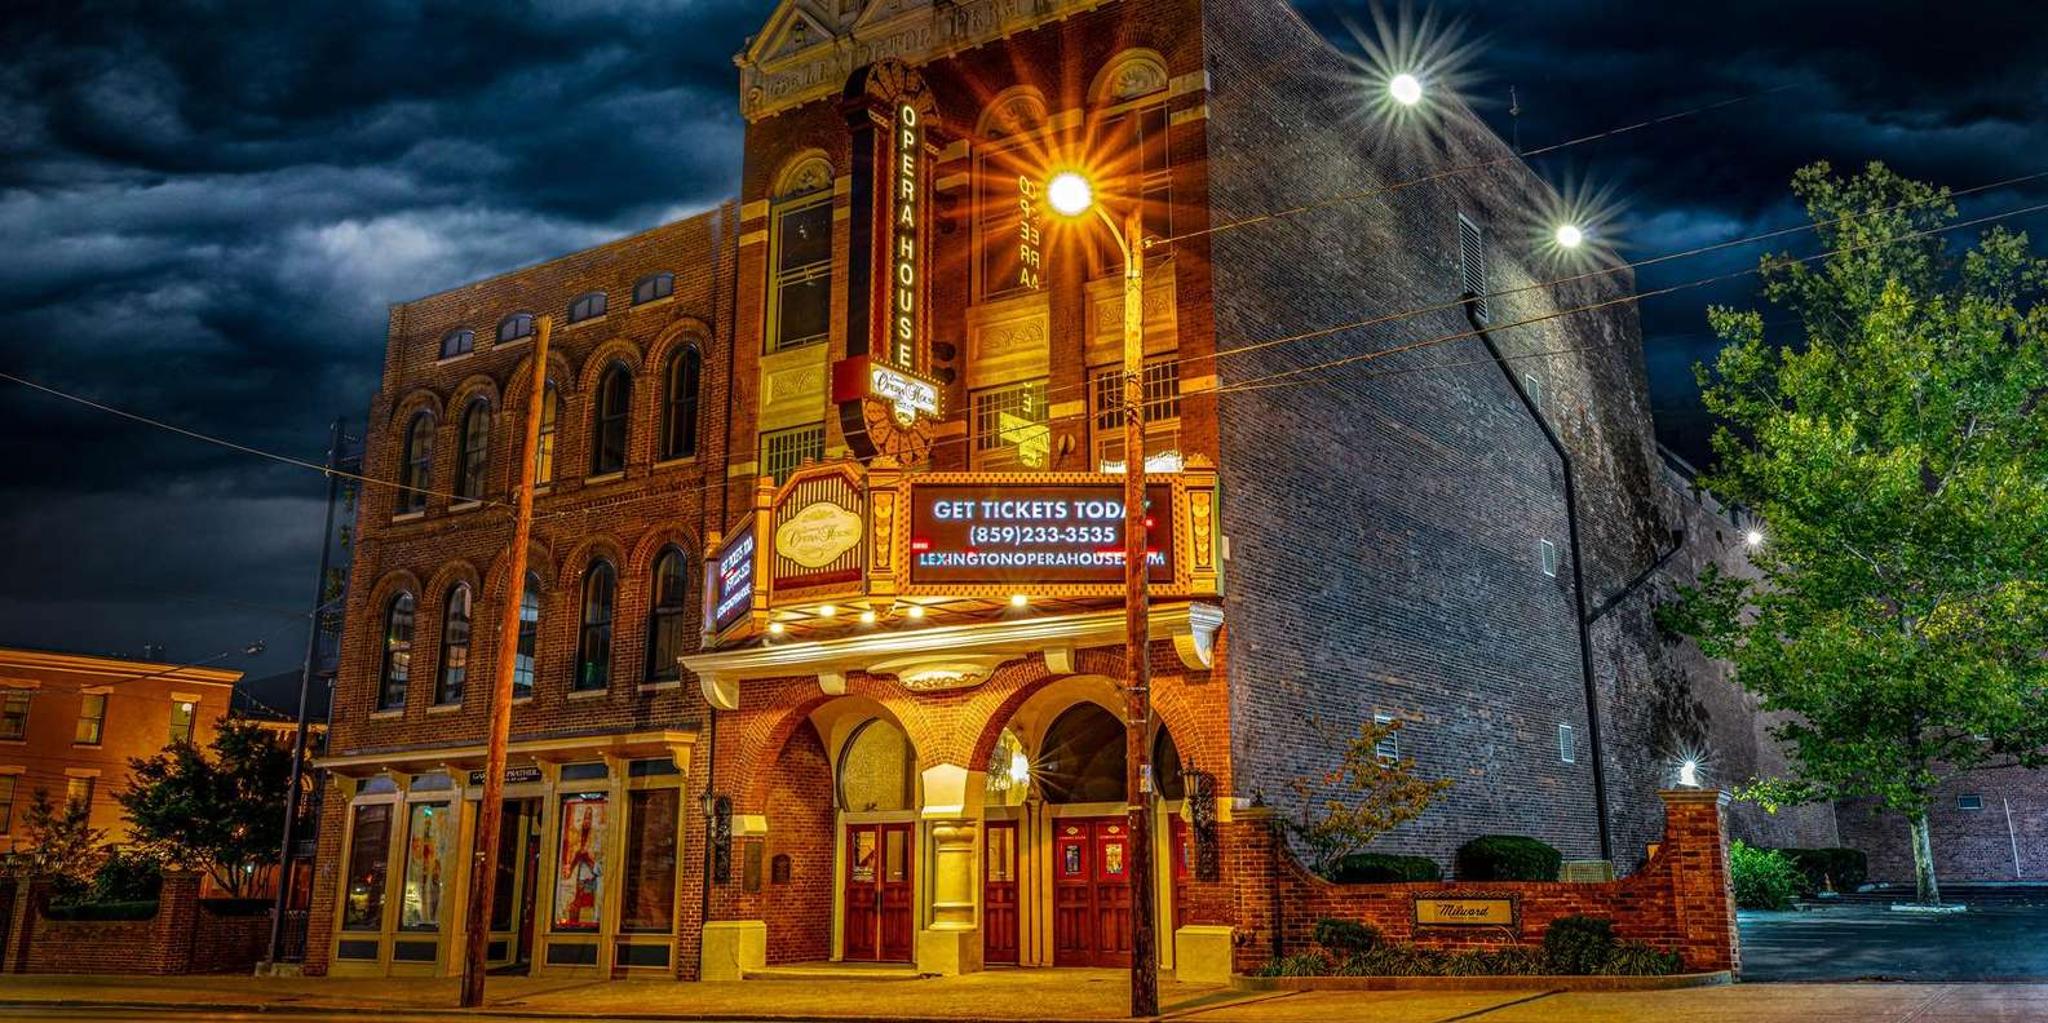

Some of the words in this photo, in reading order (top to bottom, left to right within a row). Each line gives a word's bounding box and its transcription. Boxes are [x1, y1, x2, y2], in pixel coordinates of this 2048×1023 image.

[900, 104, 917, 228] OPERA
[899, 238, 915, 368] HOUSE
[934, 500, 975, 519] GET
[982, 500, 1068, 519] TICKETS
[1074, 500, 1151, 519] TOD
[969, 525, 1116, 546] (859)233-3535
